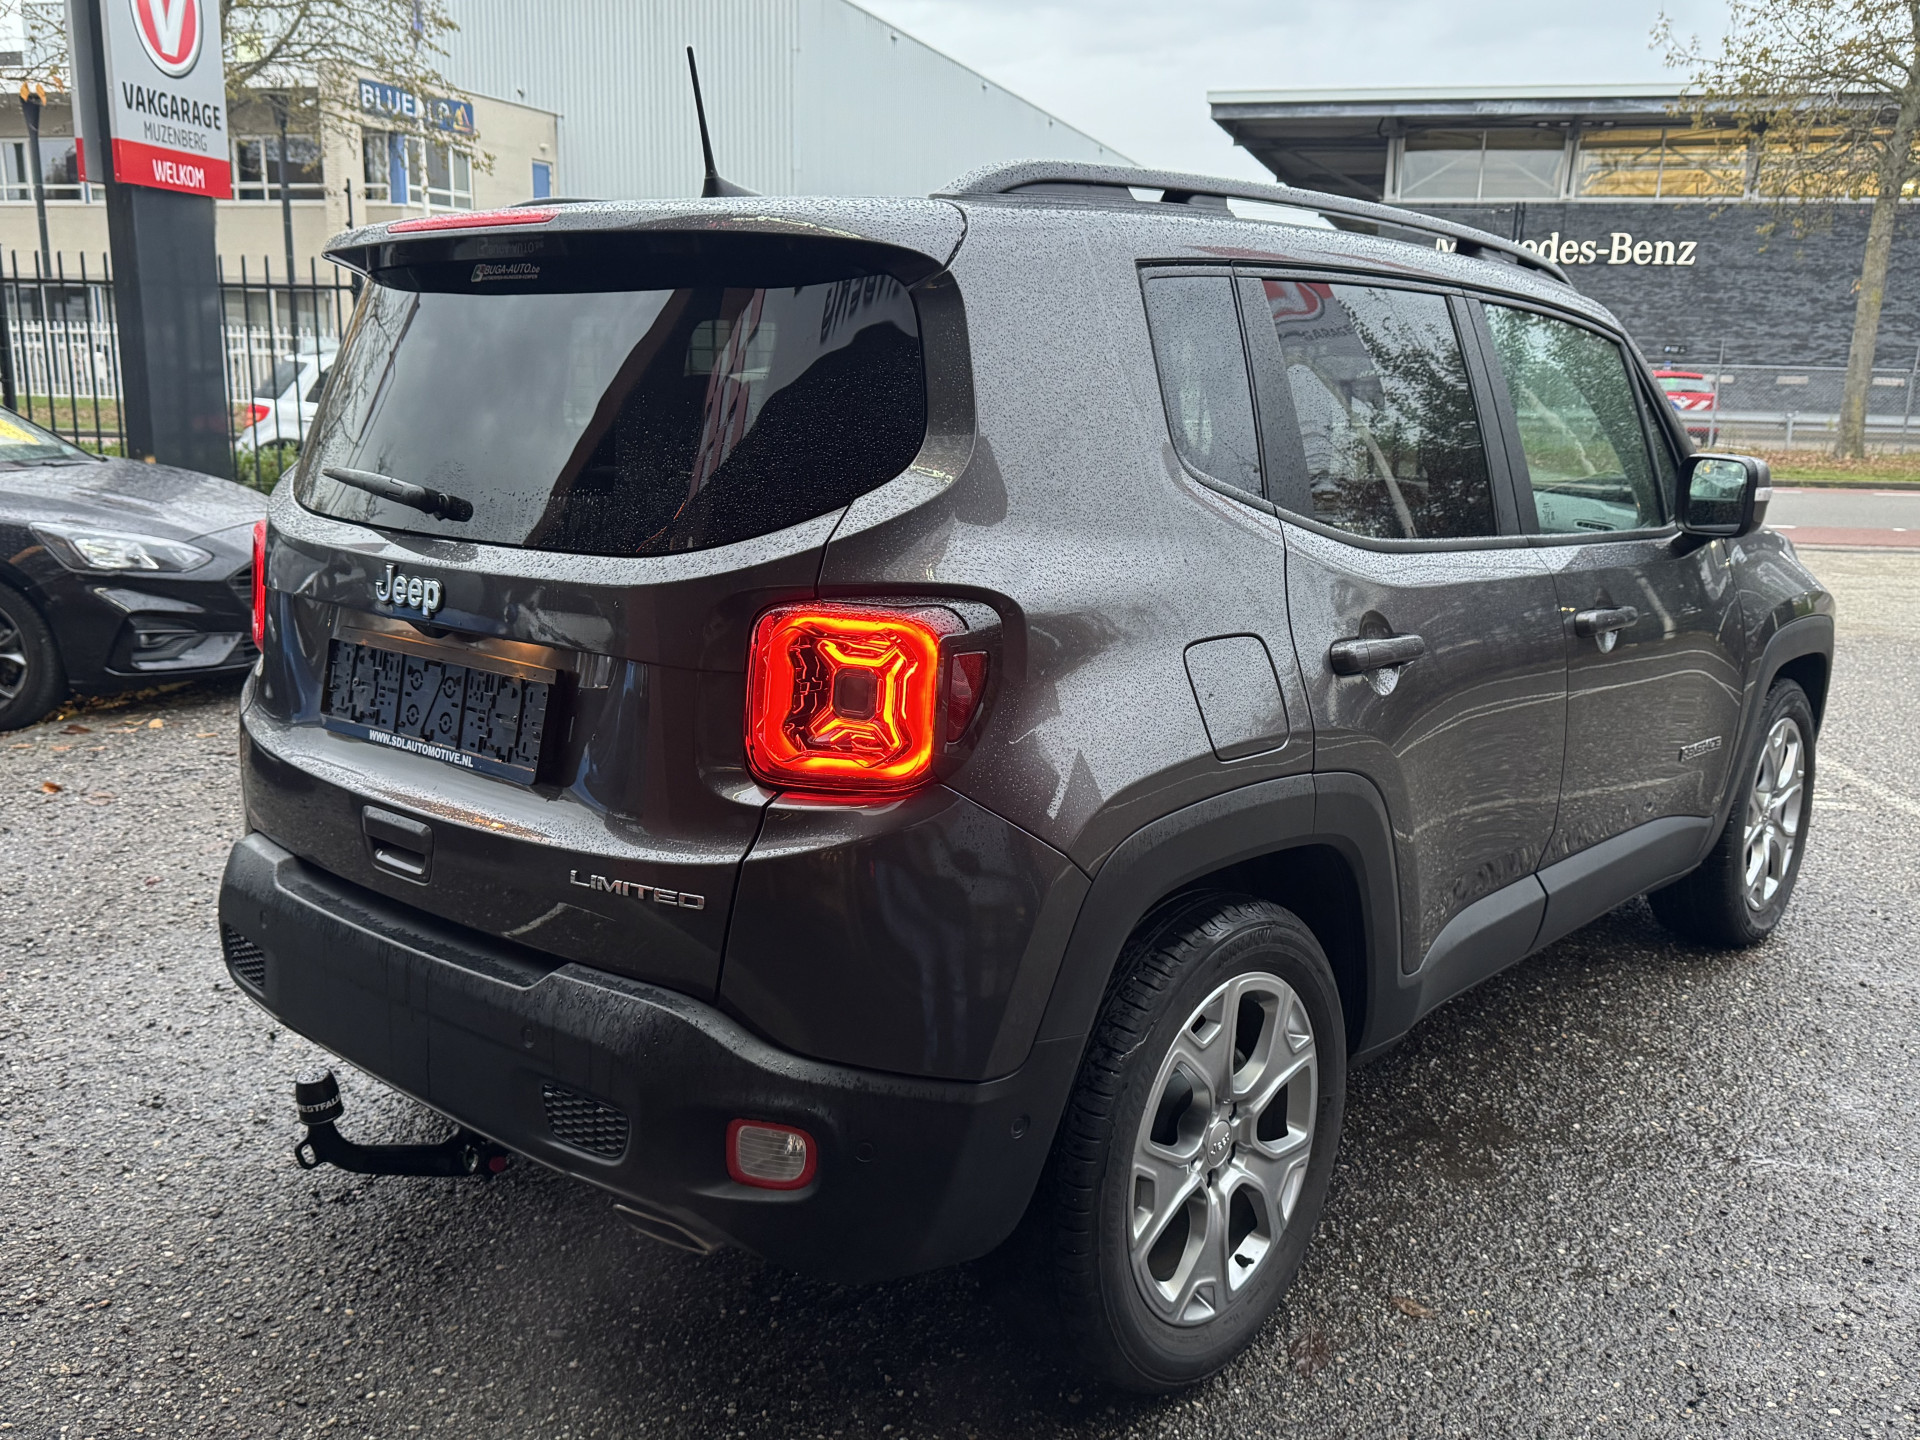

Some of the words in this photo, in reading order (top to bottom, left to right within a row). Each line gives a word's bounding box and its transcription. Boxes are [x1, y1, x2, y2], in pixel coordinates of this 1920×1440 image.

[122, 81, 222, 131] VAKGARAGE
[144, 120, 208, 152] MUZENBERG
[152, 159, 206, 189] WELKOM
[375, 562, 442, 618] Jeep
[369, 729, 474, 768] WWW.SDLAUTOMOTIVE.NL
[570, 869, 705, 910] LIMITED
